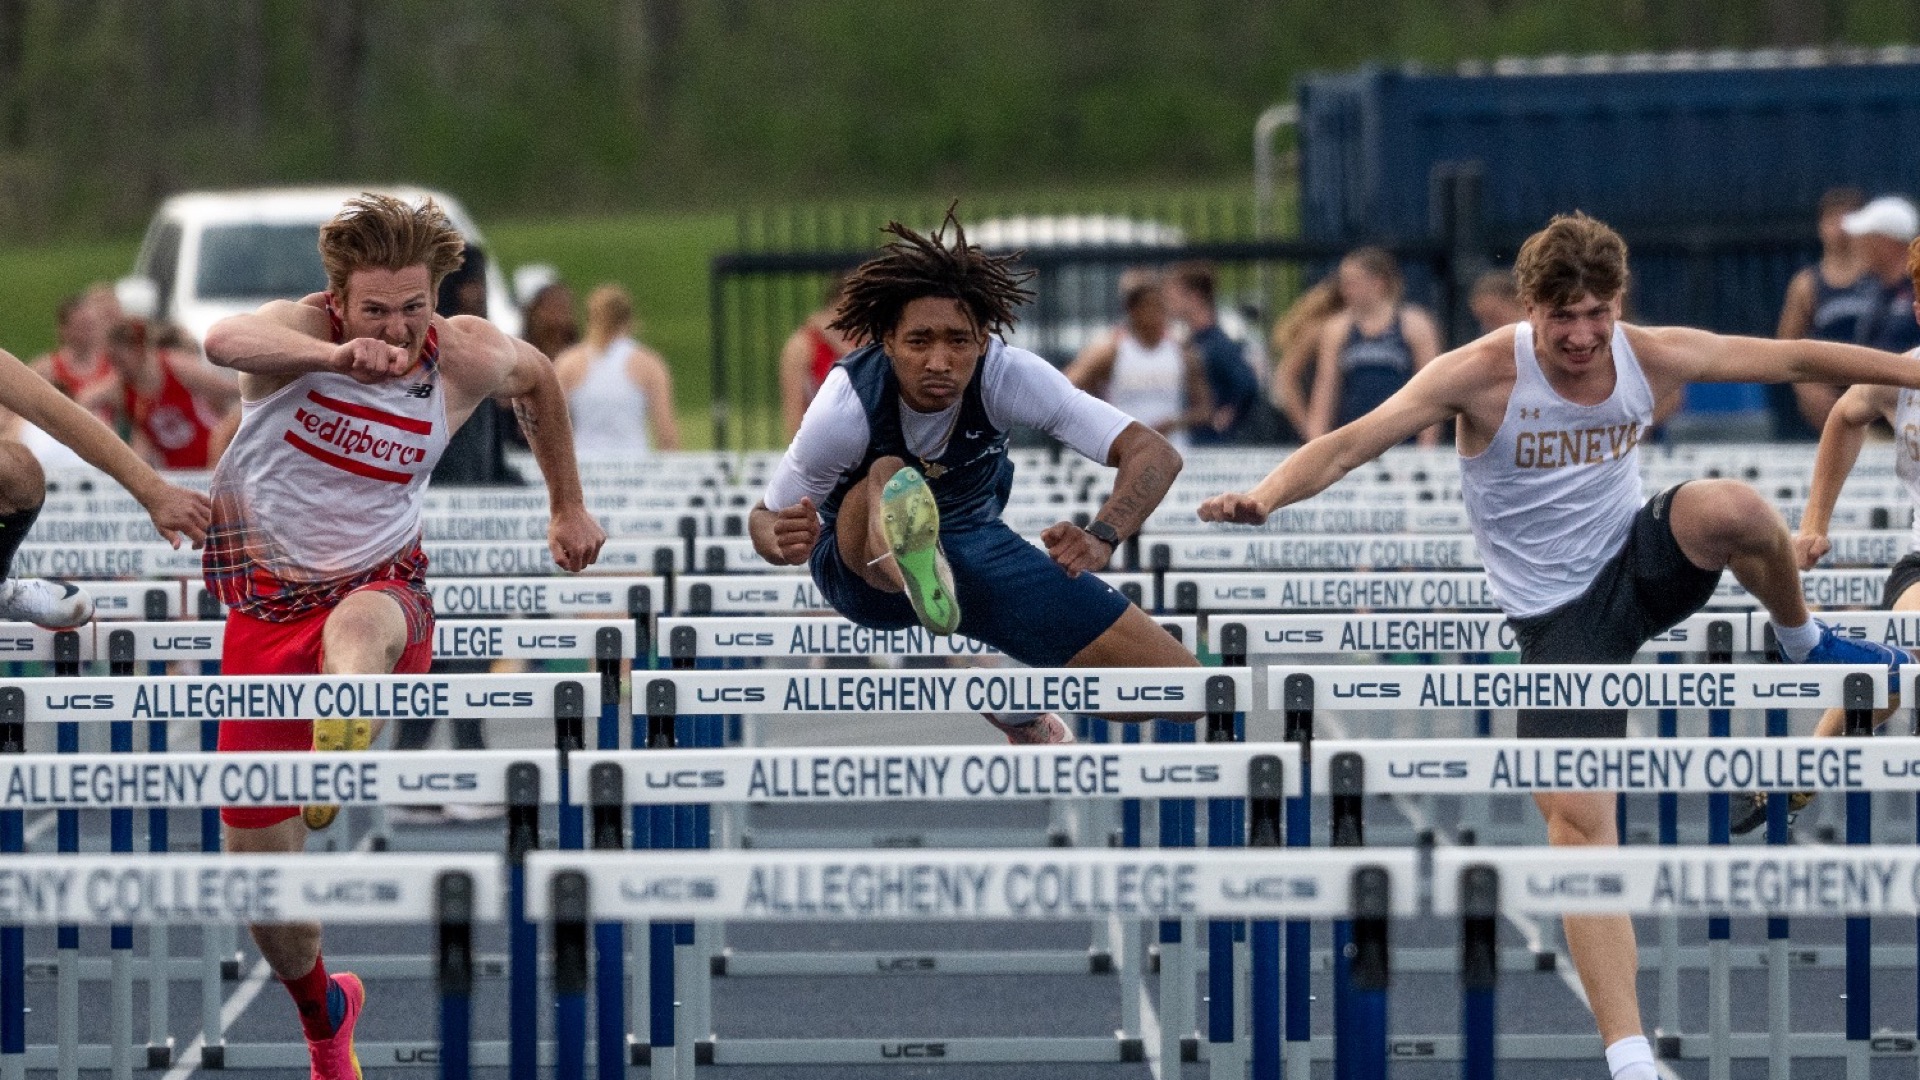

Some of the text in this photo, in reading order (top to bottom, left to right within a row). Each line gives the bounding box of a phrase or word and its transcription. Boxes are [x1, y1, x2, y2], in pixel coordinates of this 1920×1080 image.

[51, 549, 143, 575] COLLEGE
[486, 548, 548, 573] COLLE
[1245, 541, 1363, 568] ALLEGHENY
[1370, 541, 1463, 567] COLLEGE
[95, 597, 128, 608] CS
[443, 584, 612, 611] COLLEGE UCS
[726, 590, 779, 602] UCS
[1215, 586, 1266, 599] UCS
[1281, 580, 1415, 607] ALLEGHENY
[1420, 580, 1493, 606] COLLE
[0, 638, 34, 651] CS
[153, 636, 212, 650] UCS
[517, 635, 577, 648] UCS
[714, 632, 774, 646] UCS
[1264, 630, 1324, 643] UCS
[1338, 620, 1490, 650] ALLEGHENY
[45, 682, 534, 719] UCS ALLEGHENY COLLEGE UCS
[696, 676, 1185, 712] UCS ALLEGHENY COLLEGE UCS
[1332, 672, 1821, 707] UCS ALLEGHENY COLLEGE UCS
[645, 754, 1220, 798] UCS ALLEGHENY COLLEGE UCS
[1388, 760, 1468, 780] UCS
[1489, 749, 1693, 789] ALLEGHENY
[1704, 749, 1863, 789] COLLEGE
[6, 763, 478, 803] ALLEGHENY COLLEGE UCS
[85, 867, 281, 917] COLLEGE
[301, 880, 400, 903] UCS
[619, 862, 1318, 914] UCS ALLEGHENY COLLEGE UCS
[1526, 872, 1625, 897] UCS
[1650, 858, 1897, 909] ALLEGHENY
[876, 957, 936, 972] UCS
[395, 1049, 440, 1063] UC
[880, 1043, 946, 1059] UCS
[1388, 1042, 1435, 1056] CS
[1870, 1038, 1915, 1051] CS
